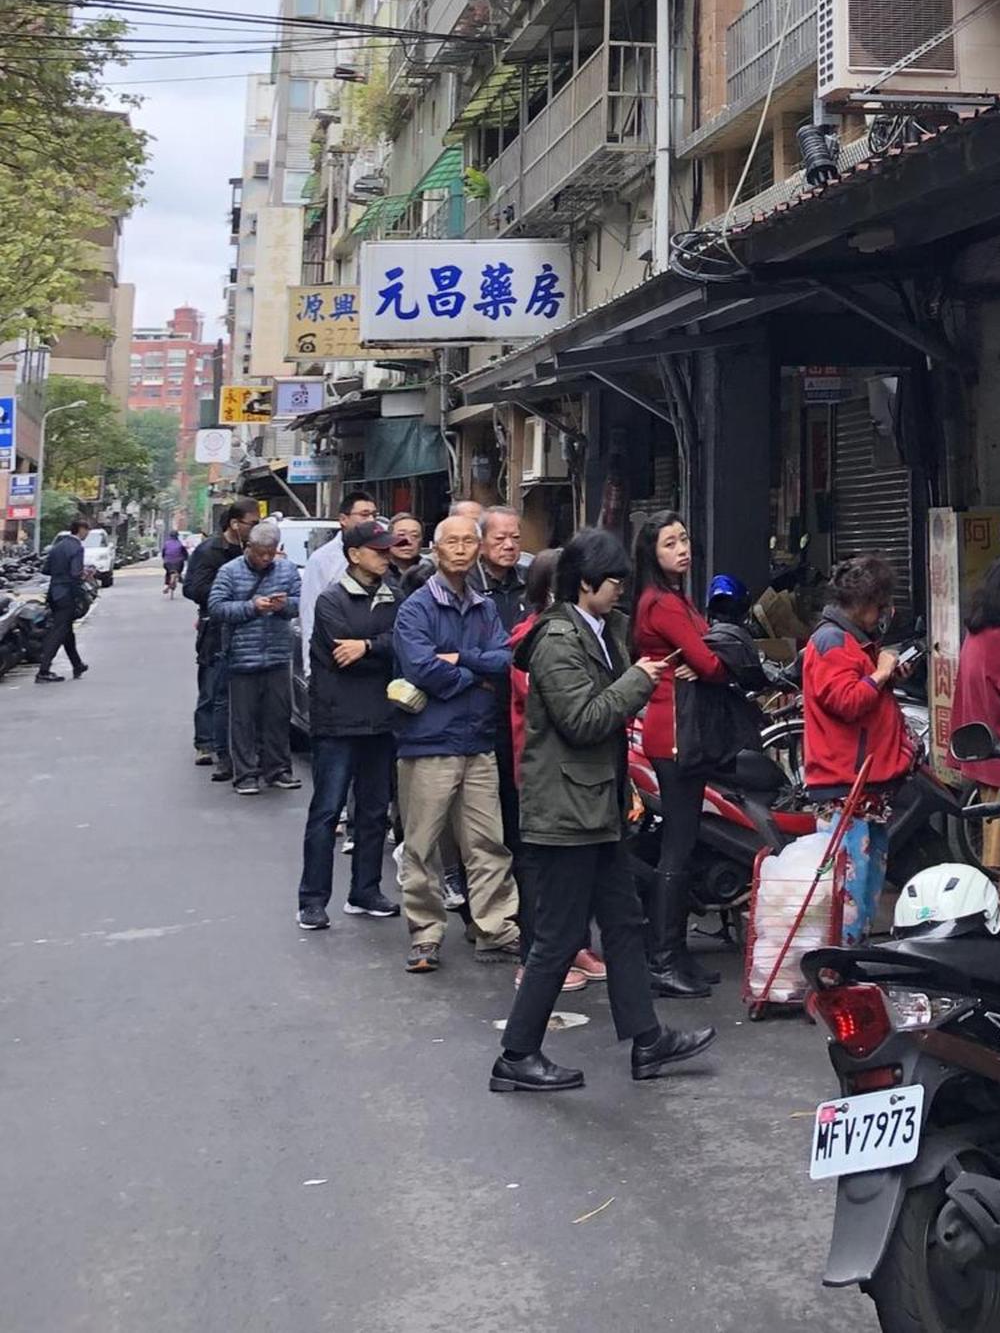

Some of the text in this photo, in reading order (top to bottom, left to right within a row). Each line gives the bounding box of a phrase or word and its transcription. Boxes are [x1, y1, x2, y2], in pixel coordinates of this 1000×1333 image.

[296, 293, 359, 322] 源興
[376, 263, 565, 321] 元昌藥房
